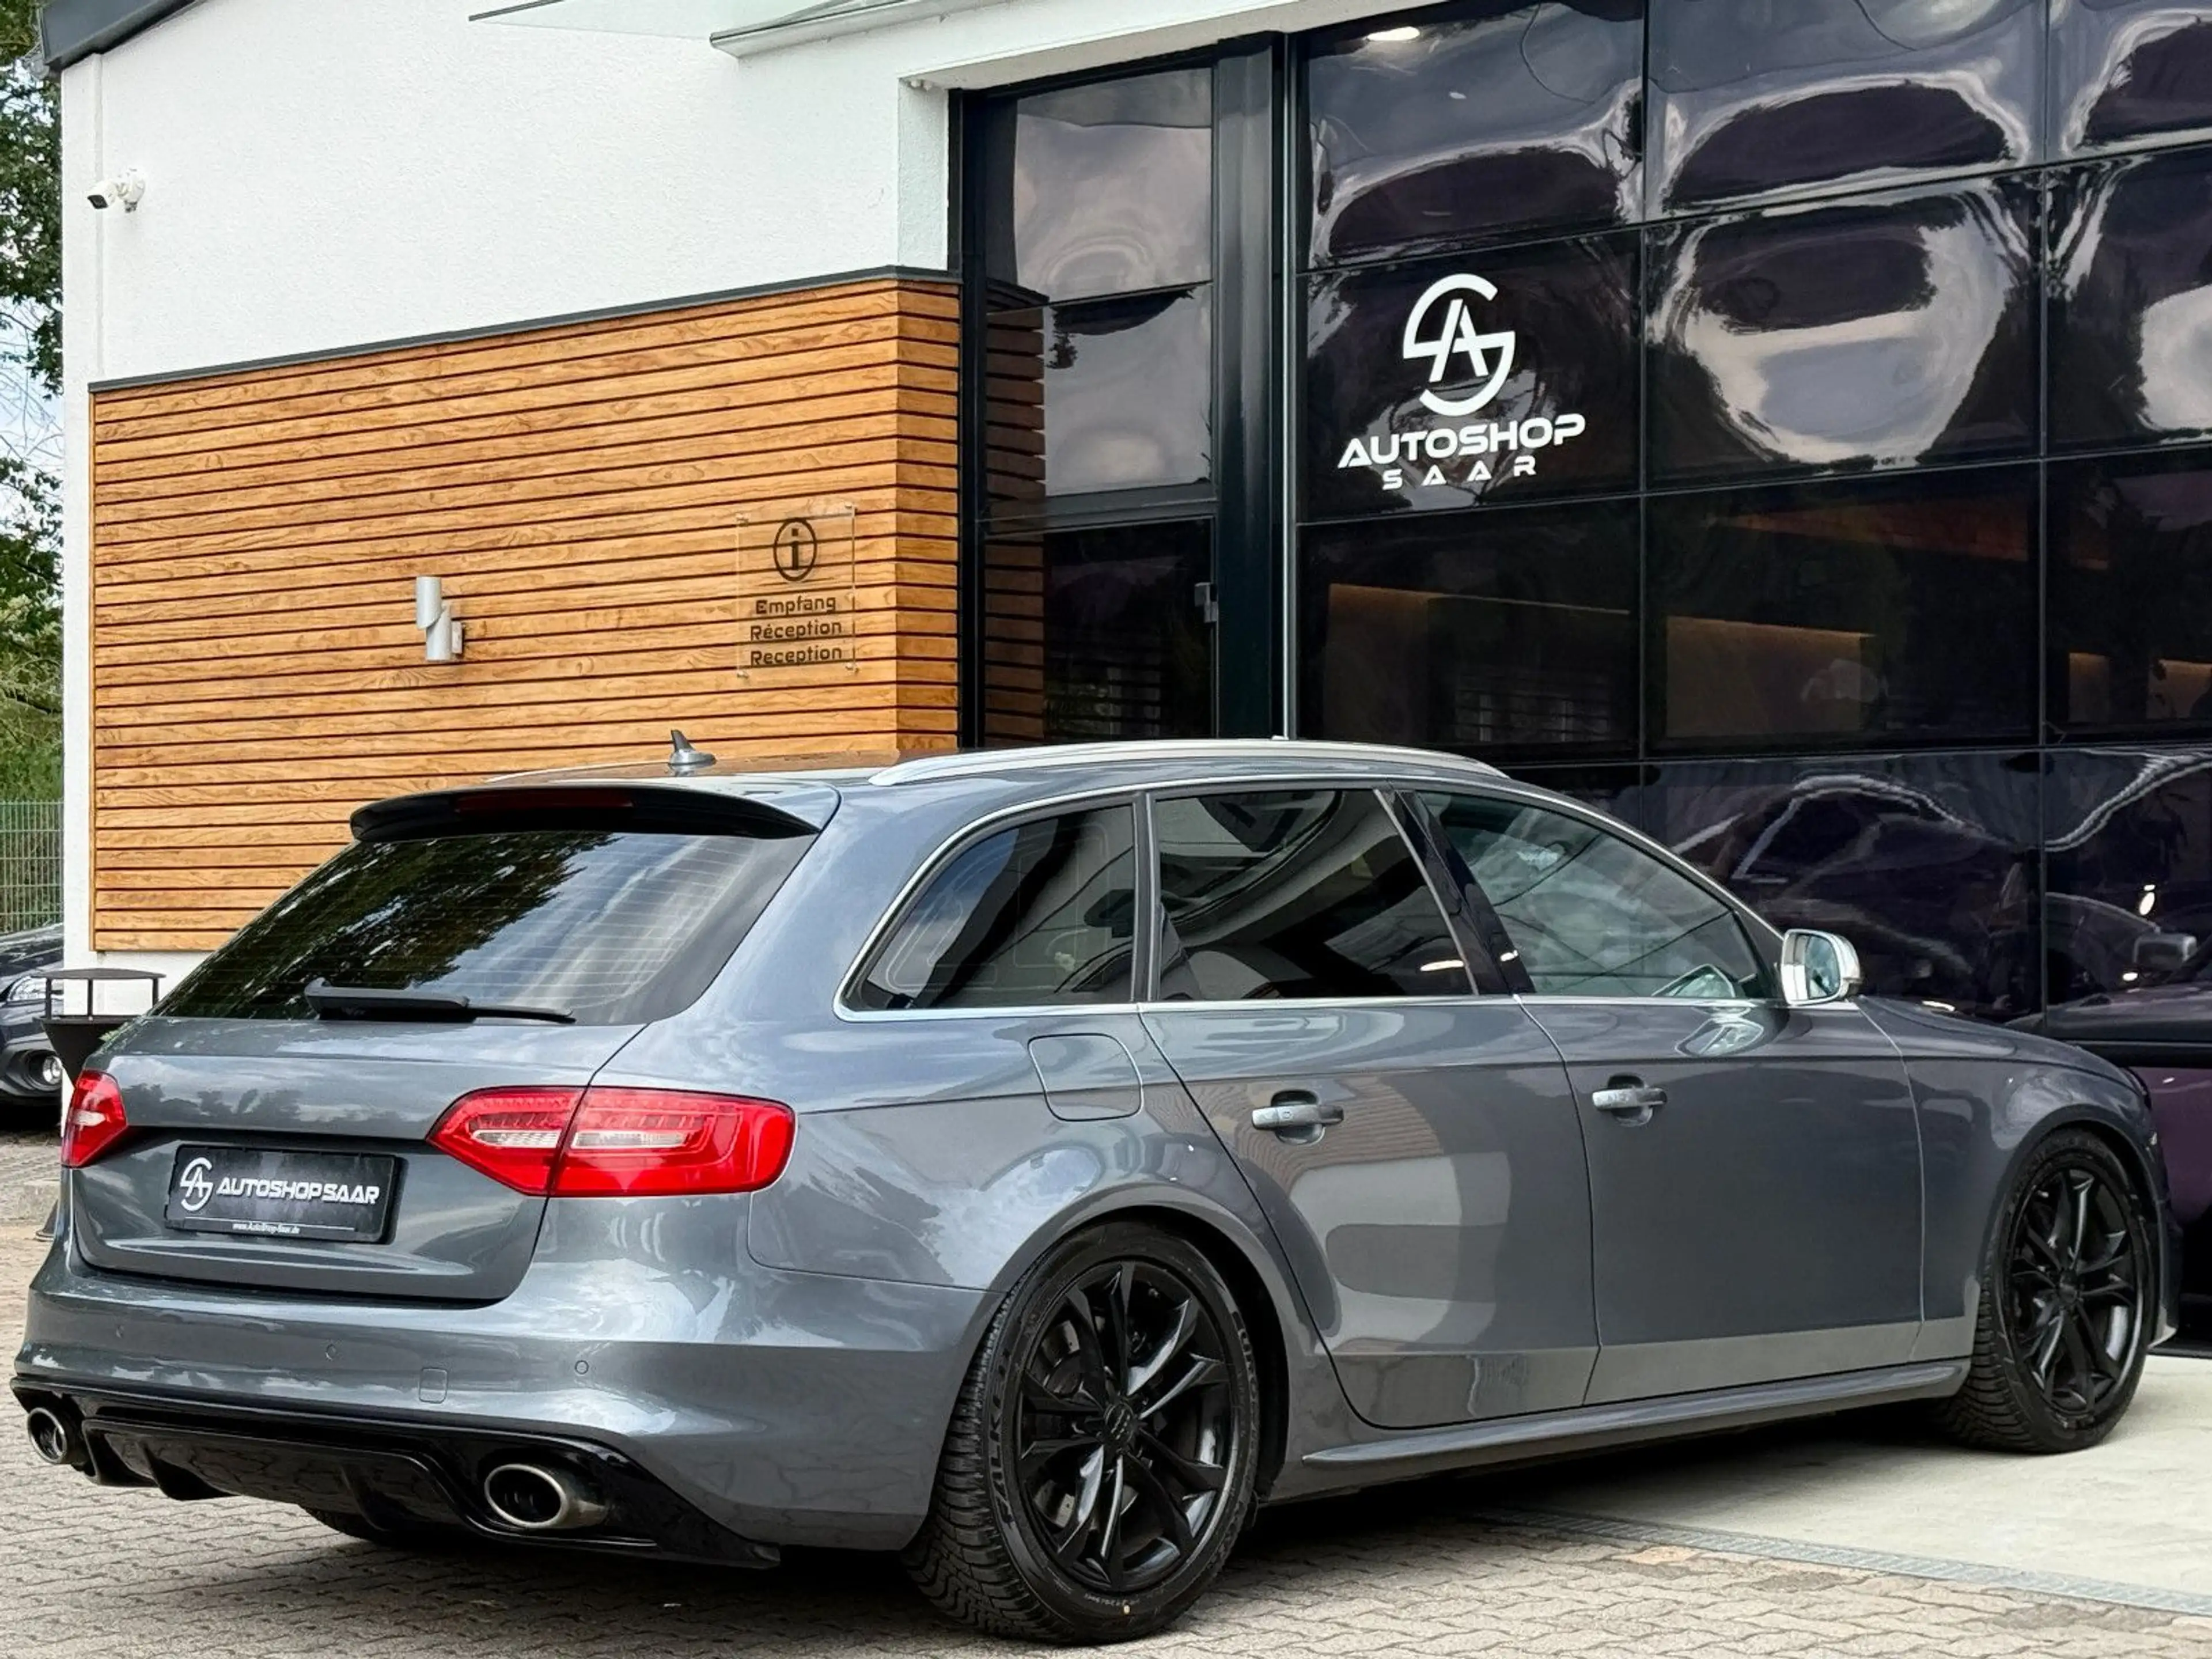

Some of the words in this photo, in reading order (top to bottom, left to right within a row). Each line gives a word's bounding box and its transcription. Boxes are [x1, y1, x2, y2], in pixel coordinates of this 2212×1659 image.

[1338, 414, 1586, 468] AUTOSHOP
[1382, 456, 1536, 490] SAAR
[755, 596, 836, 615] Empfang
[750, 619, 842, 641] Réception
[750, 645, 842, 665] Reception
[216, 1177, 380, 1205] AUTOSHOPSAAR
